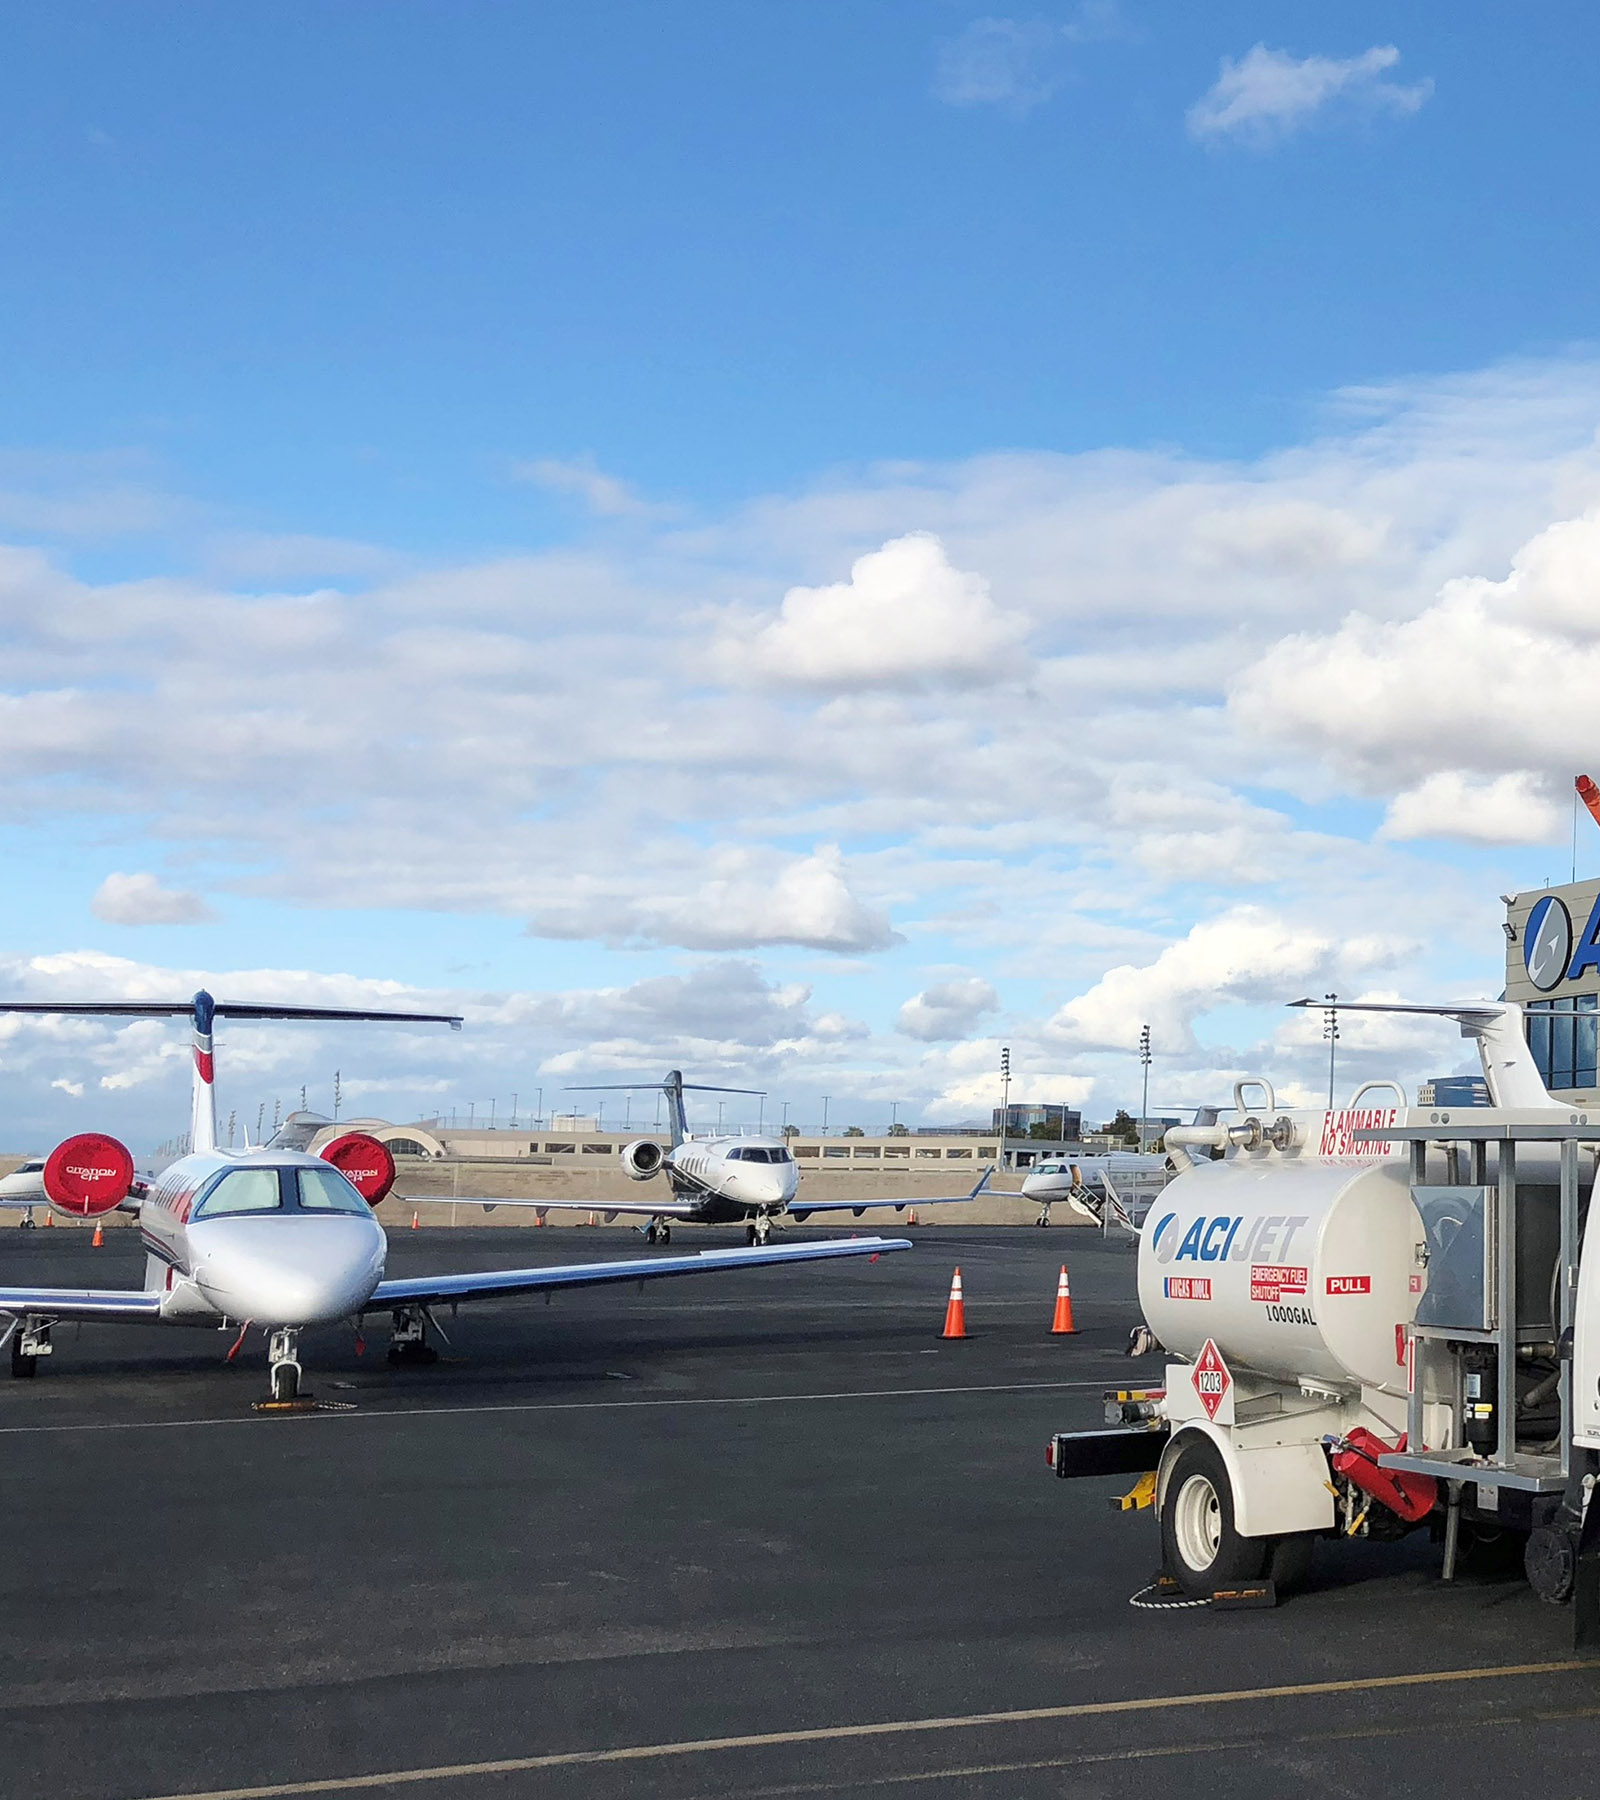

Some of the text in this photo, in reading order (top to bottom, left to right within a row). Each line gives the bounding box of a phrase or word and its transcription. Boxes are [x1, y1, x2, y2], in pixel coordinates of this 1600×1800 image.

[1324, 1109, 1396, 1133] FLAMMABLE
[1319, 1132, 1391, 1155] NO SMOKING
[66, 1166, 117, 1176] CITATION
[341, 1169, 378, 1177] TATION
[1252, 1267, 1306, 1284] EMERGENCY FUEL
[1252, 1284, 1279, 1300] SHUTOFF
[1331, 1279, 1365, 1292] PULL
[1266, 1304, 1317, 1326] 1000GAL
[1200, 1372, 1221, 1392] 1203
[1208, 1398, 1214, 1410] 3
